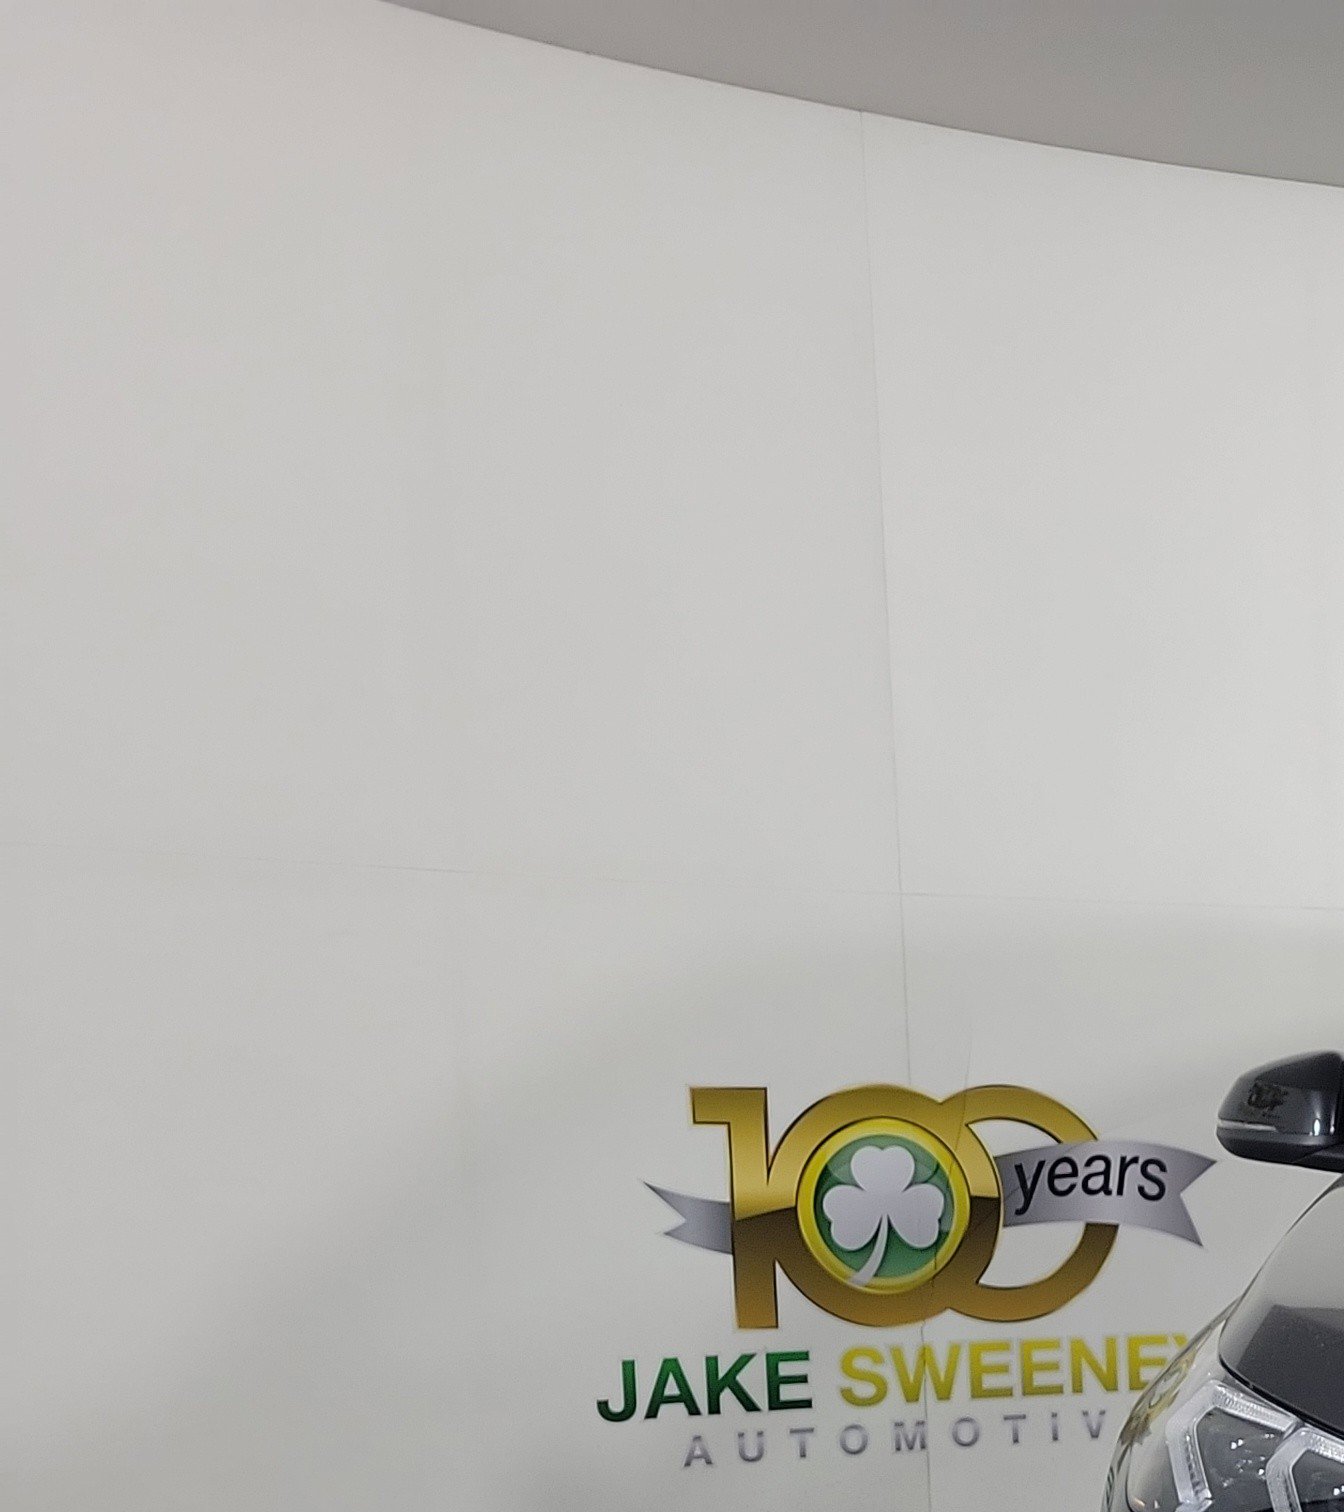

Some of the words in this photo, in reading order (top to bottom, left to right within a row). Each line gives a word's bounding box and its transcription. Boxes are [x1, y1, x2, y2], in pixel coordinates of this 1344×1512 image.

[1013, 1152, 1168, 1216] years
[596, 1349, 814, 1423] JAKE
[838, 1333, 1188, 1408] SWEENE
[683, 1409, 1108, 1469] AUTOMOTIV
